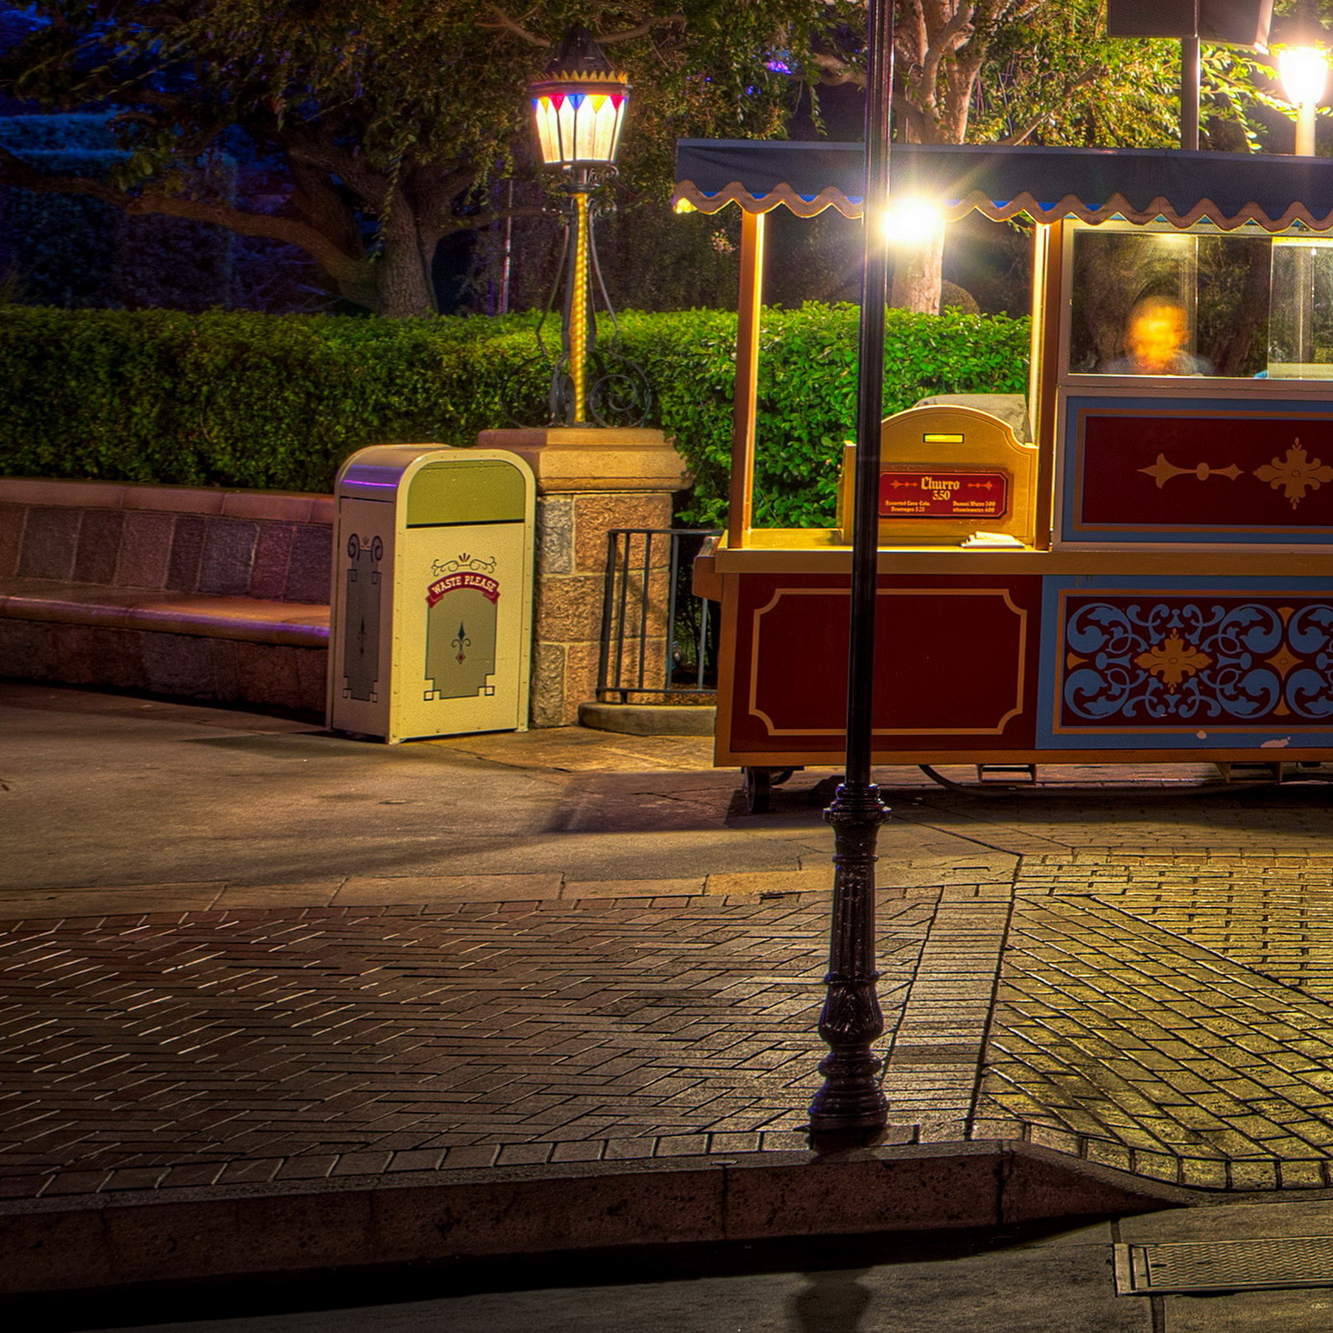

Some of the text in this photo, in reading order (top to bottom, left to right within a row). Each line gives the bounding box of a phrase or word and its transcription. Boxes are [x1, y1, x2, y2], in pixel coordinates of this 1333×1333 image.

[921, 476, 960, 490] Churro
[431, 575, 497, 595] WASTE PLEASE
